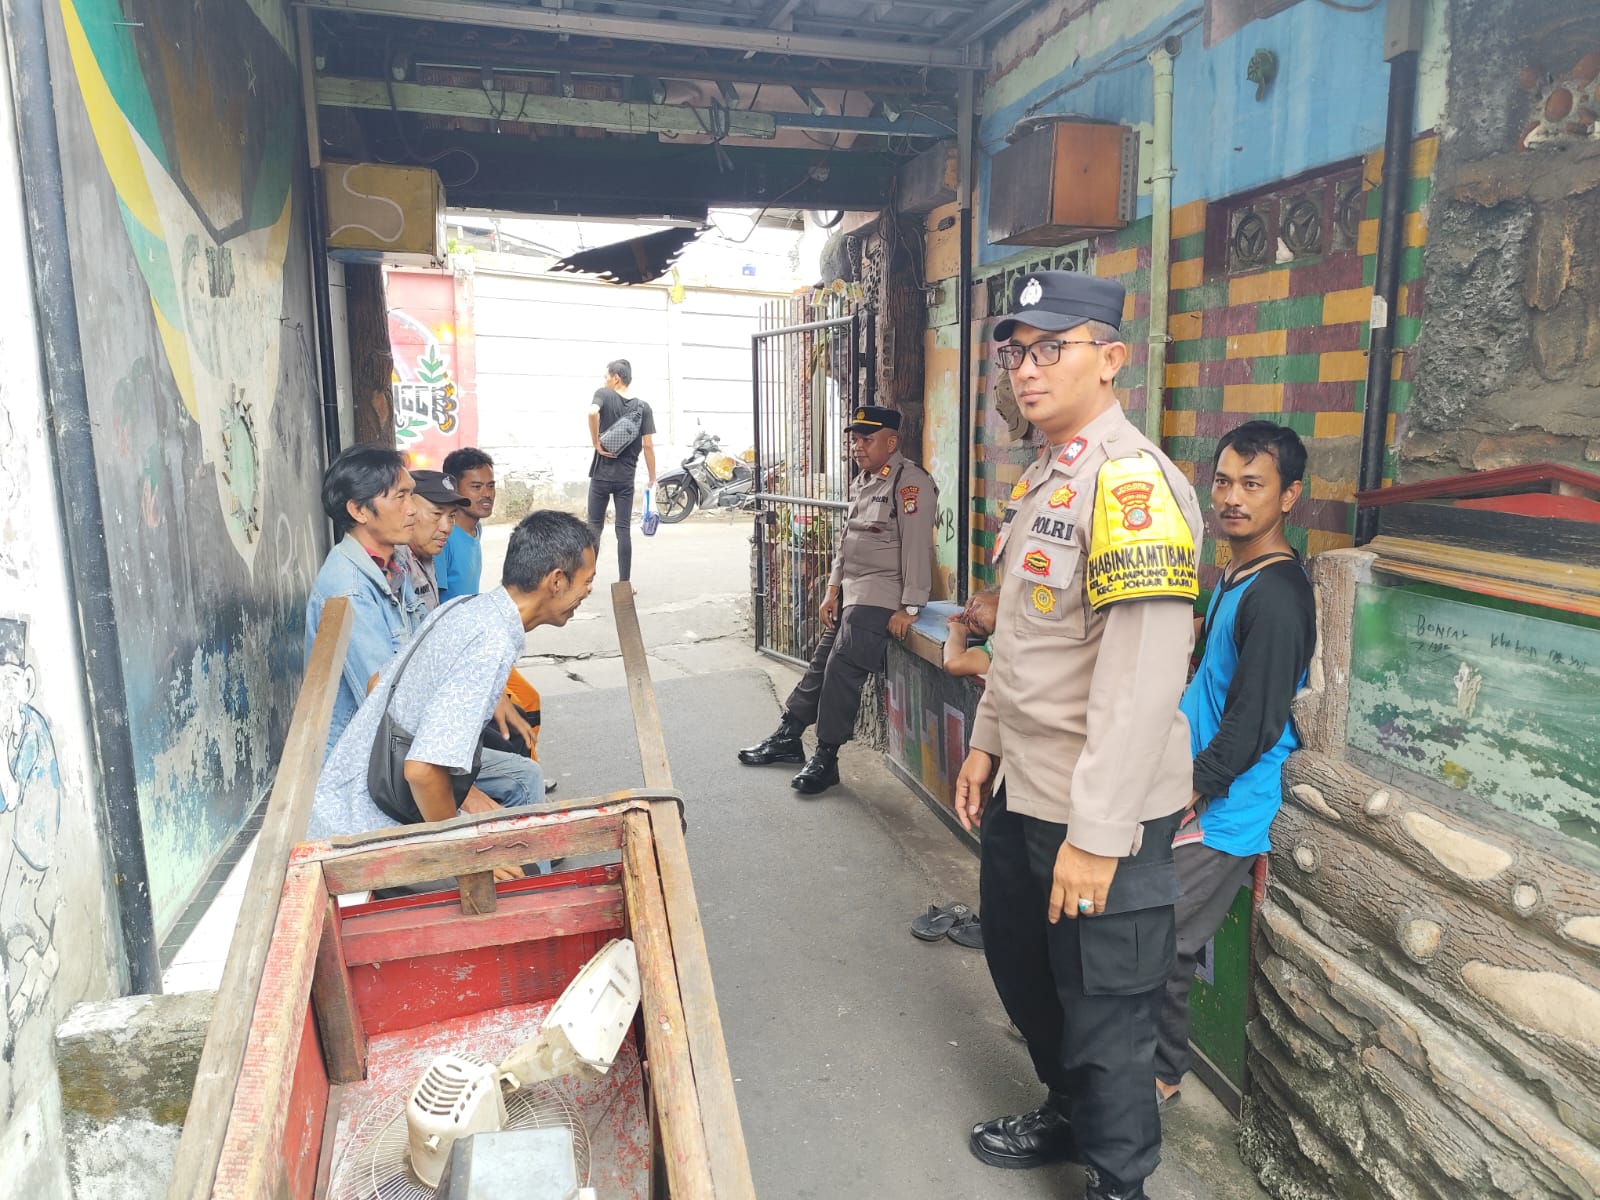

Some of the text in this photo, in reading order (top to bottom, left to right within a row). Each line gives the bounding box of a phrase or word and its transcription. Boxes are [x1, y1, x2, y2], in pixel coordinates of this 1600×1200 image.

[1031, 516, 1074, 541] POLRI
[1107, 568, 1168, 584] KAMPUNG
[1122, 577, 1162, 590] JOHAR
